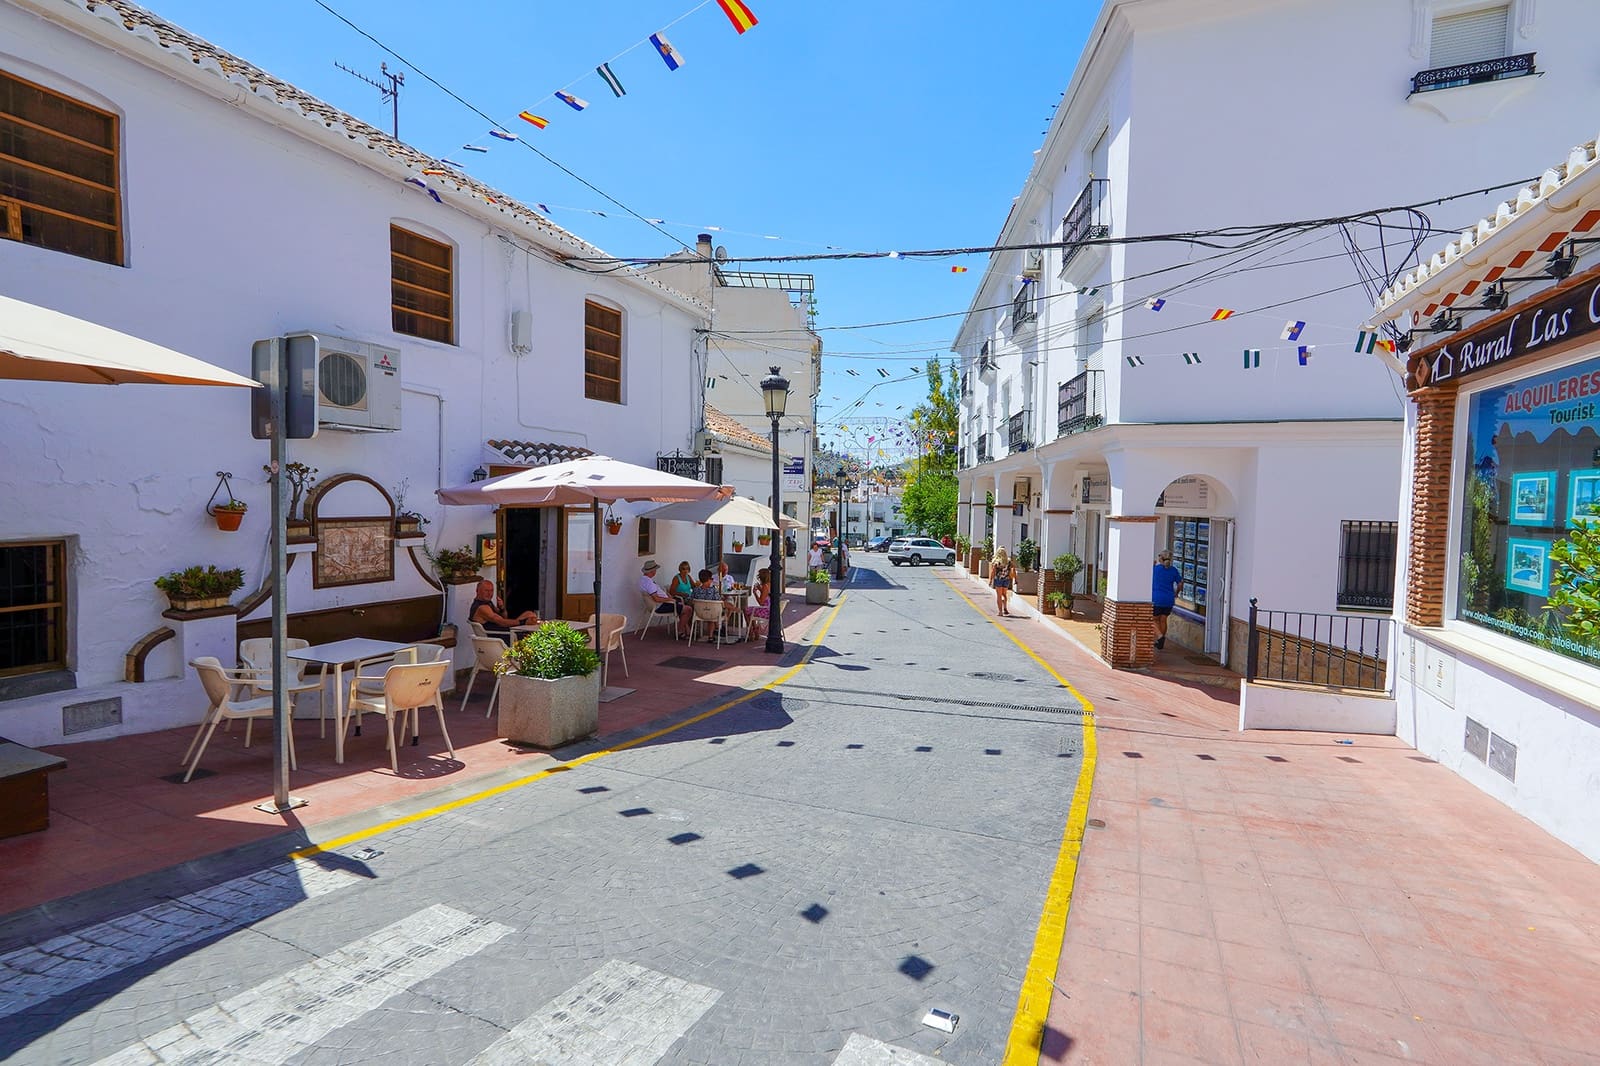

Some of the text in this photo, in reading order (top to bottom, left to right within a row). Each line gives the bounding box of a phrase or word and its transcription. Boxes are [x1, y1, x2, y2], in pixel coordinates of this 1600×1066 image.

[1459, 313, 1520, 373] Rural
[1526, 308, 1573, 348] Las
[1504, 370, 1600, 414] ALQUILERES
[1549, 401, 1595, 425] Tourist
